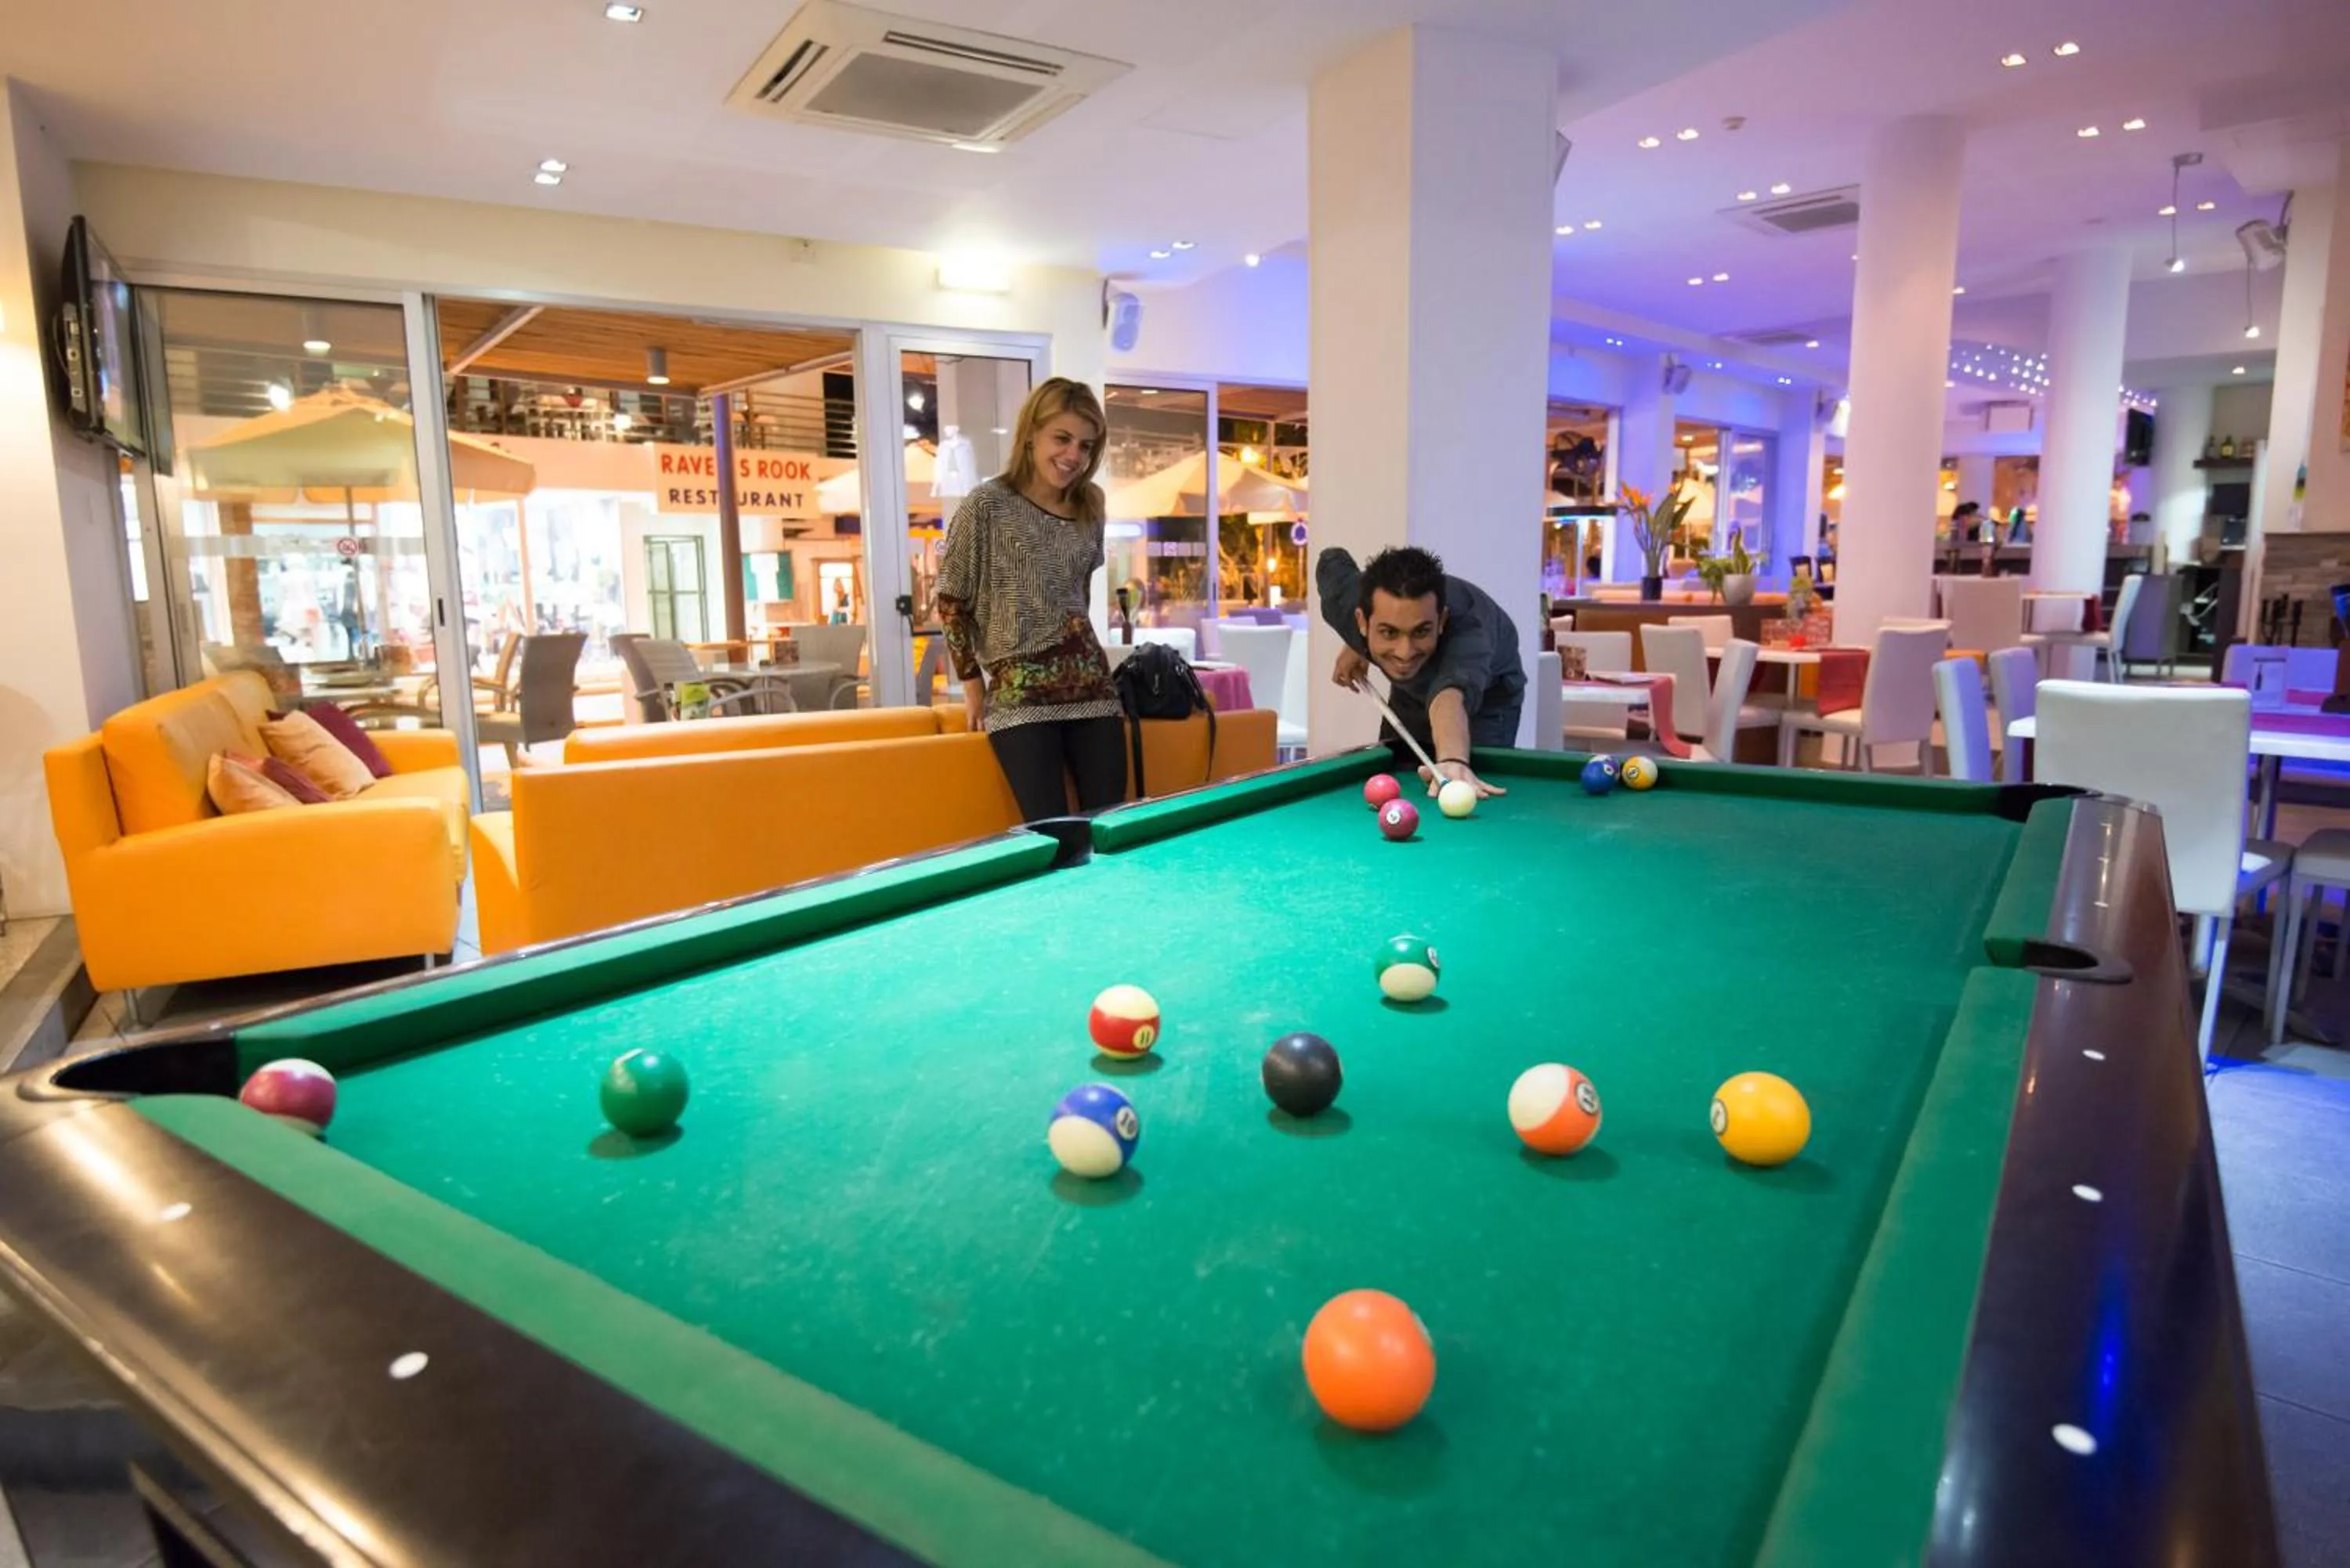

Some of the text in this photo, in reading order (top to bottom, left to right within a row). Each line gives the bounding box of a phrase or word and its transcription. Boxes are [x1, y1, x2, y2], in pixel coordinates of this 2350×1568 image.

[660, 453, 811, 481] RAVES ROOK
[669, 488, 803, 509] RESTURANT
